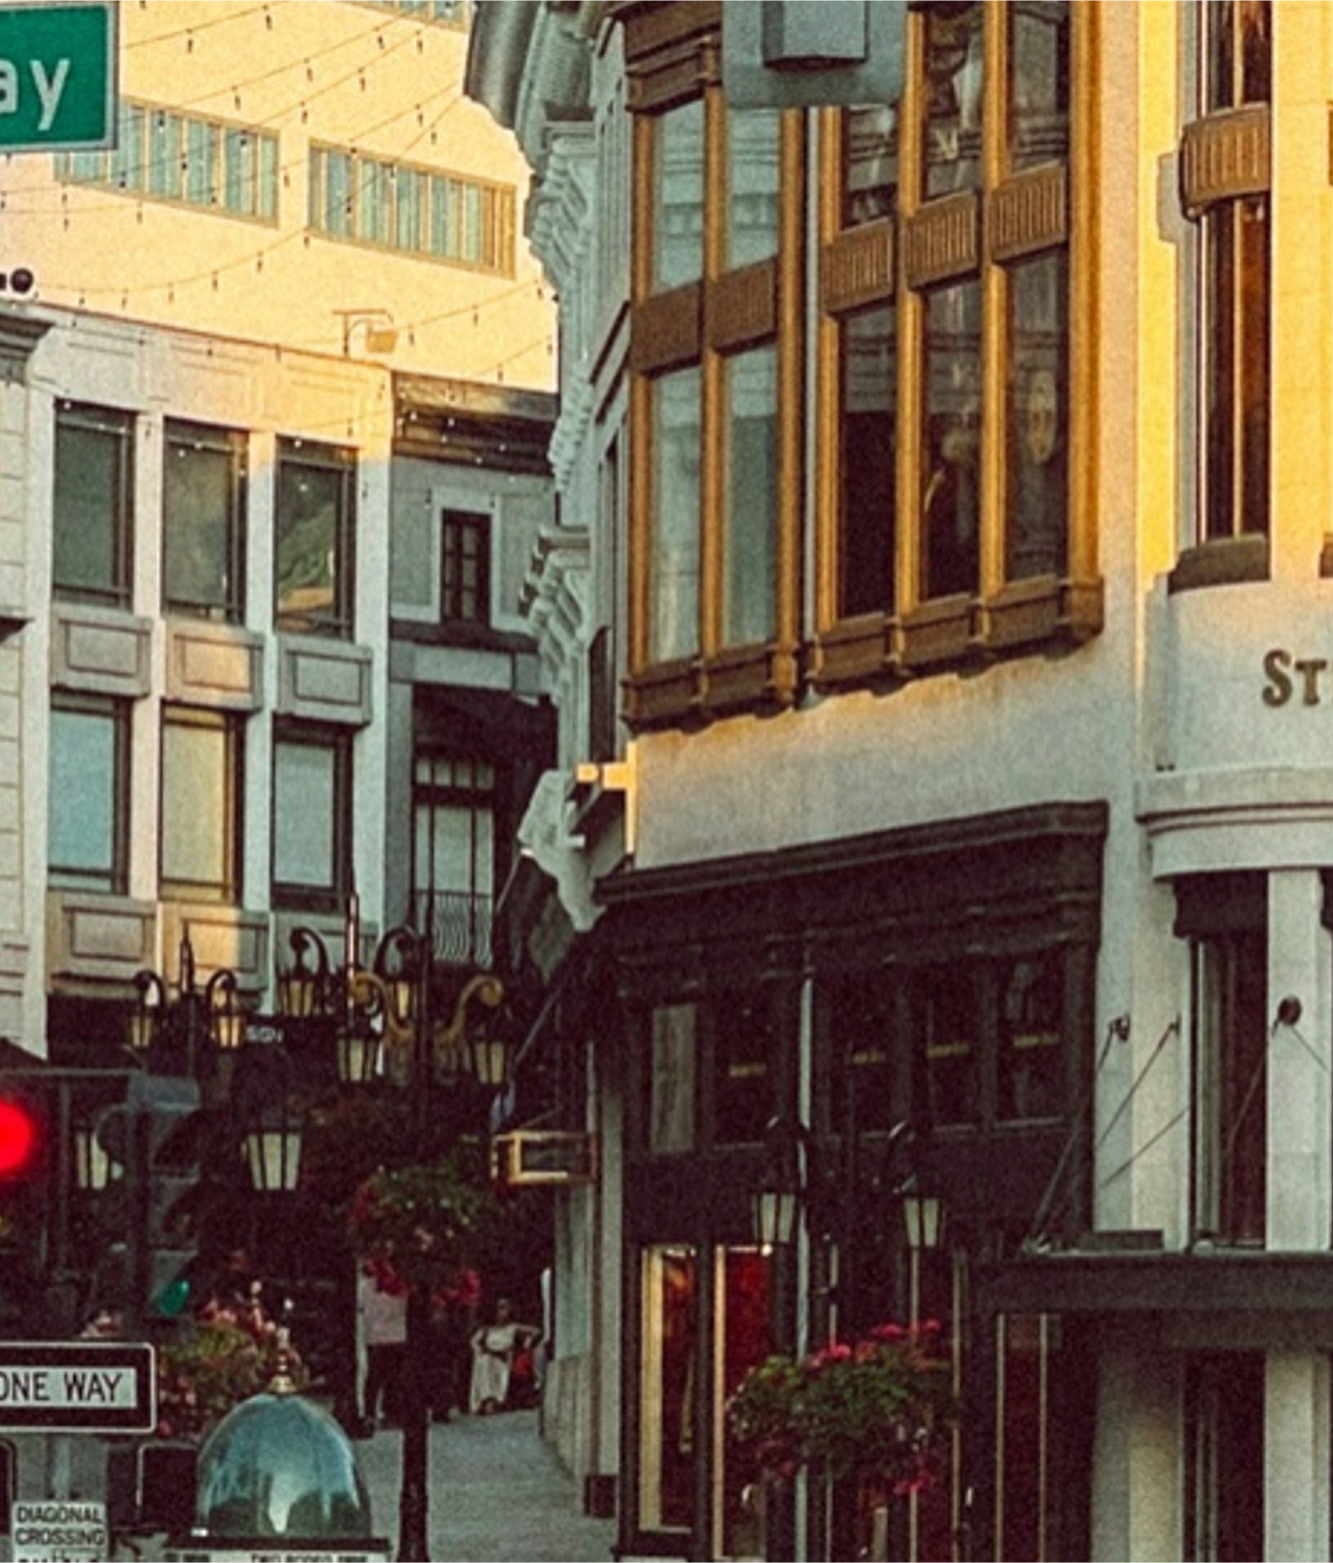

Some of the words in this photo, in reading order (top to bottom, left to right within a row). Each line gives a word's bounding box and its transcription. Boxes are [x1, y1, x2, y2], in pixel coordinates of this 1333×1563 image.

[63, 1371, 123, 1402] WAY
[17, 1506, 103, 1525] DIAGONAL
[15, 1528, 106, 1546] CROSSING
